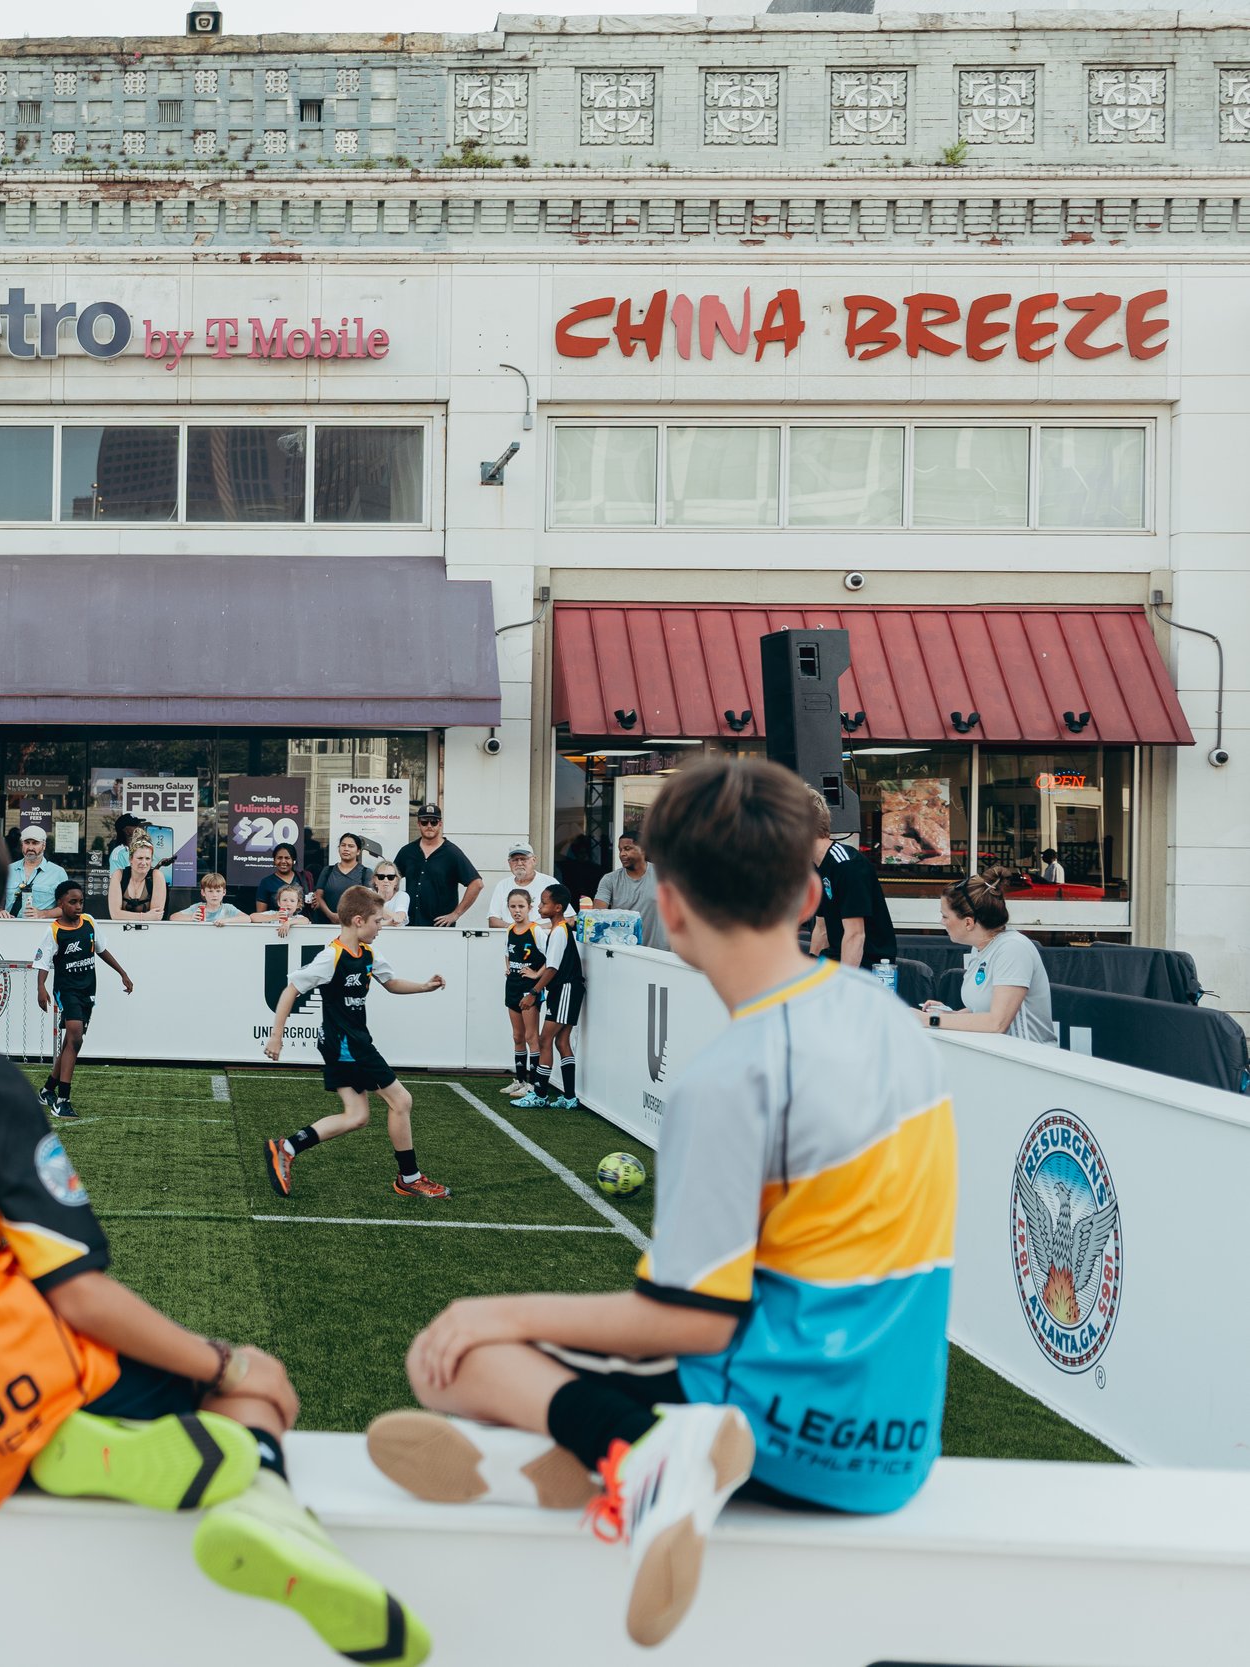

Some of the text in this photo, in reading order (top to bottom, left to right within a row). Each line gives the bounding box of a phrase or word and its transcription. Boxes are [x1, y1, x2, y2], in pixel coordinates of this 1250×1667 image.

[555, 286, 1170, 363] CHINA BREEZE
[143, 319, 194, 370] by
[206, 317, 239, 359] T
[249, 317, 390, 361] Mobile
[8, 777, 42, 788] metro
[126, 782, 194, 792] Samsung Galaxy
[337, 783, 403, 794] iPhone 16e
[1035, 773, 1086, 790] OPEN
[126, 791, 195, 813] FREE
[234, 803, 299, 814] Unlimited 5G
[251, 795, 281, 803] One line
[349, 795, 392, 806] ON US
[234, 816, 300, 849] $20
[523, 943, 532, 961] 5
[1024, 1127, 1107, 1207] RESURGENS
[1017, 1217, 1030, 1278] 1847
[1098, 1253, 1114, 1319] 1865
[765, 1394, 928, 1452] LEGADO
